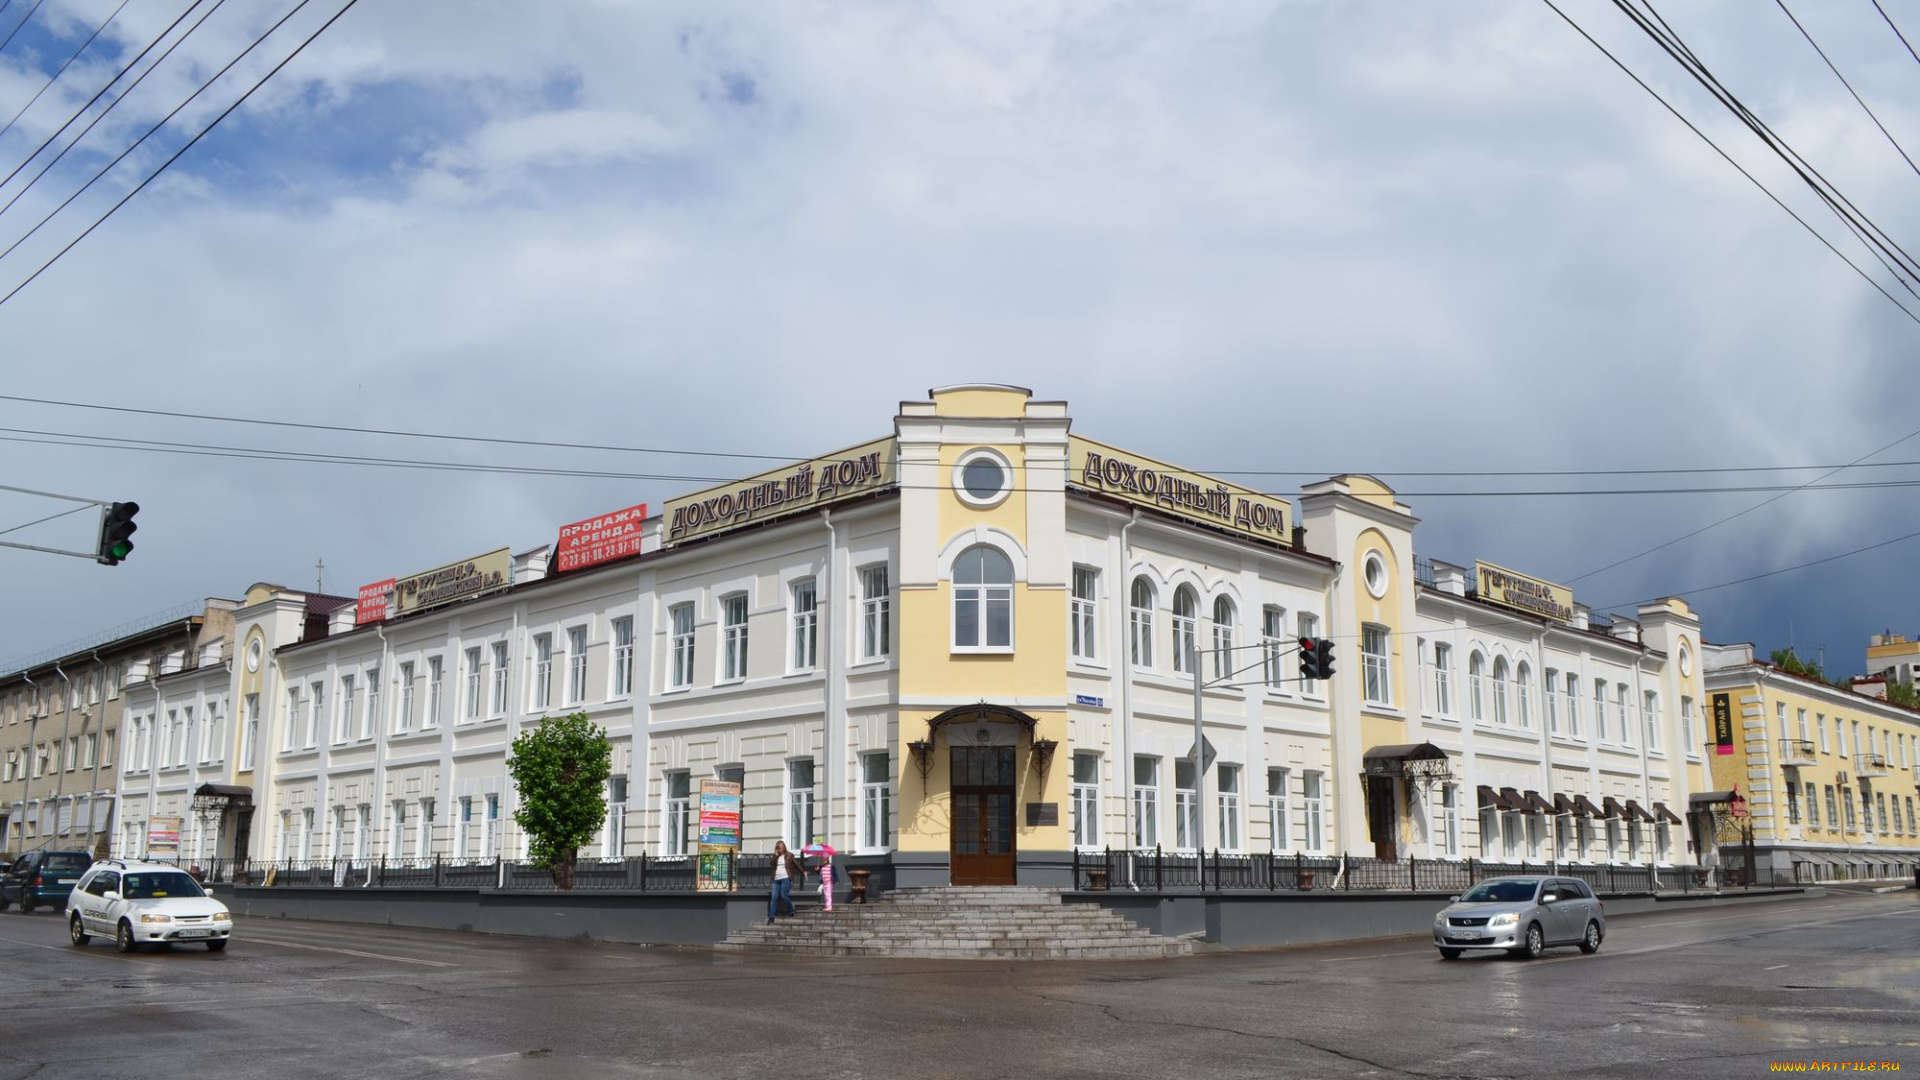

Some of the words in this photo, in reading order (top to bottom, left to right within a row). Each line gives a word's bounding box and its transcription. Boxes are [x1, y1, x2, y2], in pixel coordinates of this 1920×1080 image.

[670, 465, 813, 538] ДОХОДНЫЙ
[816, 451, 881, 499] ДОМ
[1084, 451, 1232, 519] ДОХОДНЫЙ
[1234, 497, 1284, 534] ДОМ
[562, 508, 641, 537] ПРОДАЖА
[570, 523, 635, 547] АРЕНДА
[359, 583, 394, 599] ПРОДАЖА
[1718, 709, 1727, 739] ТАЙРАЙ
